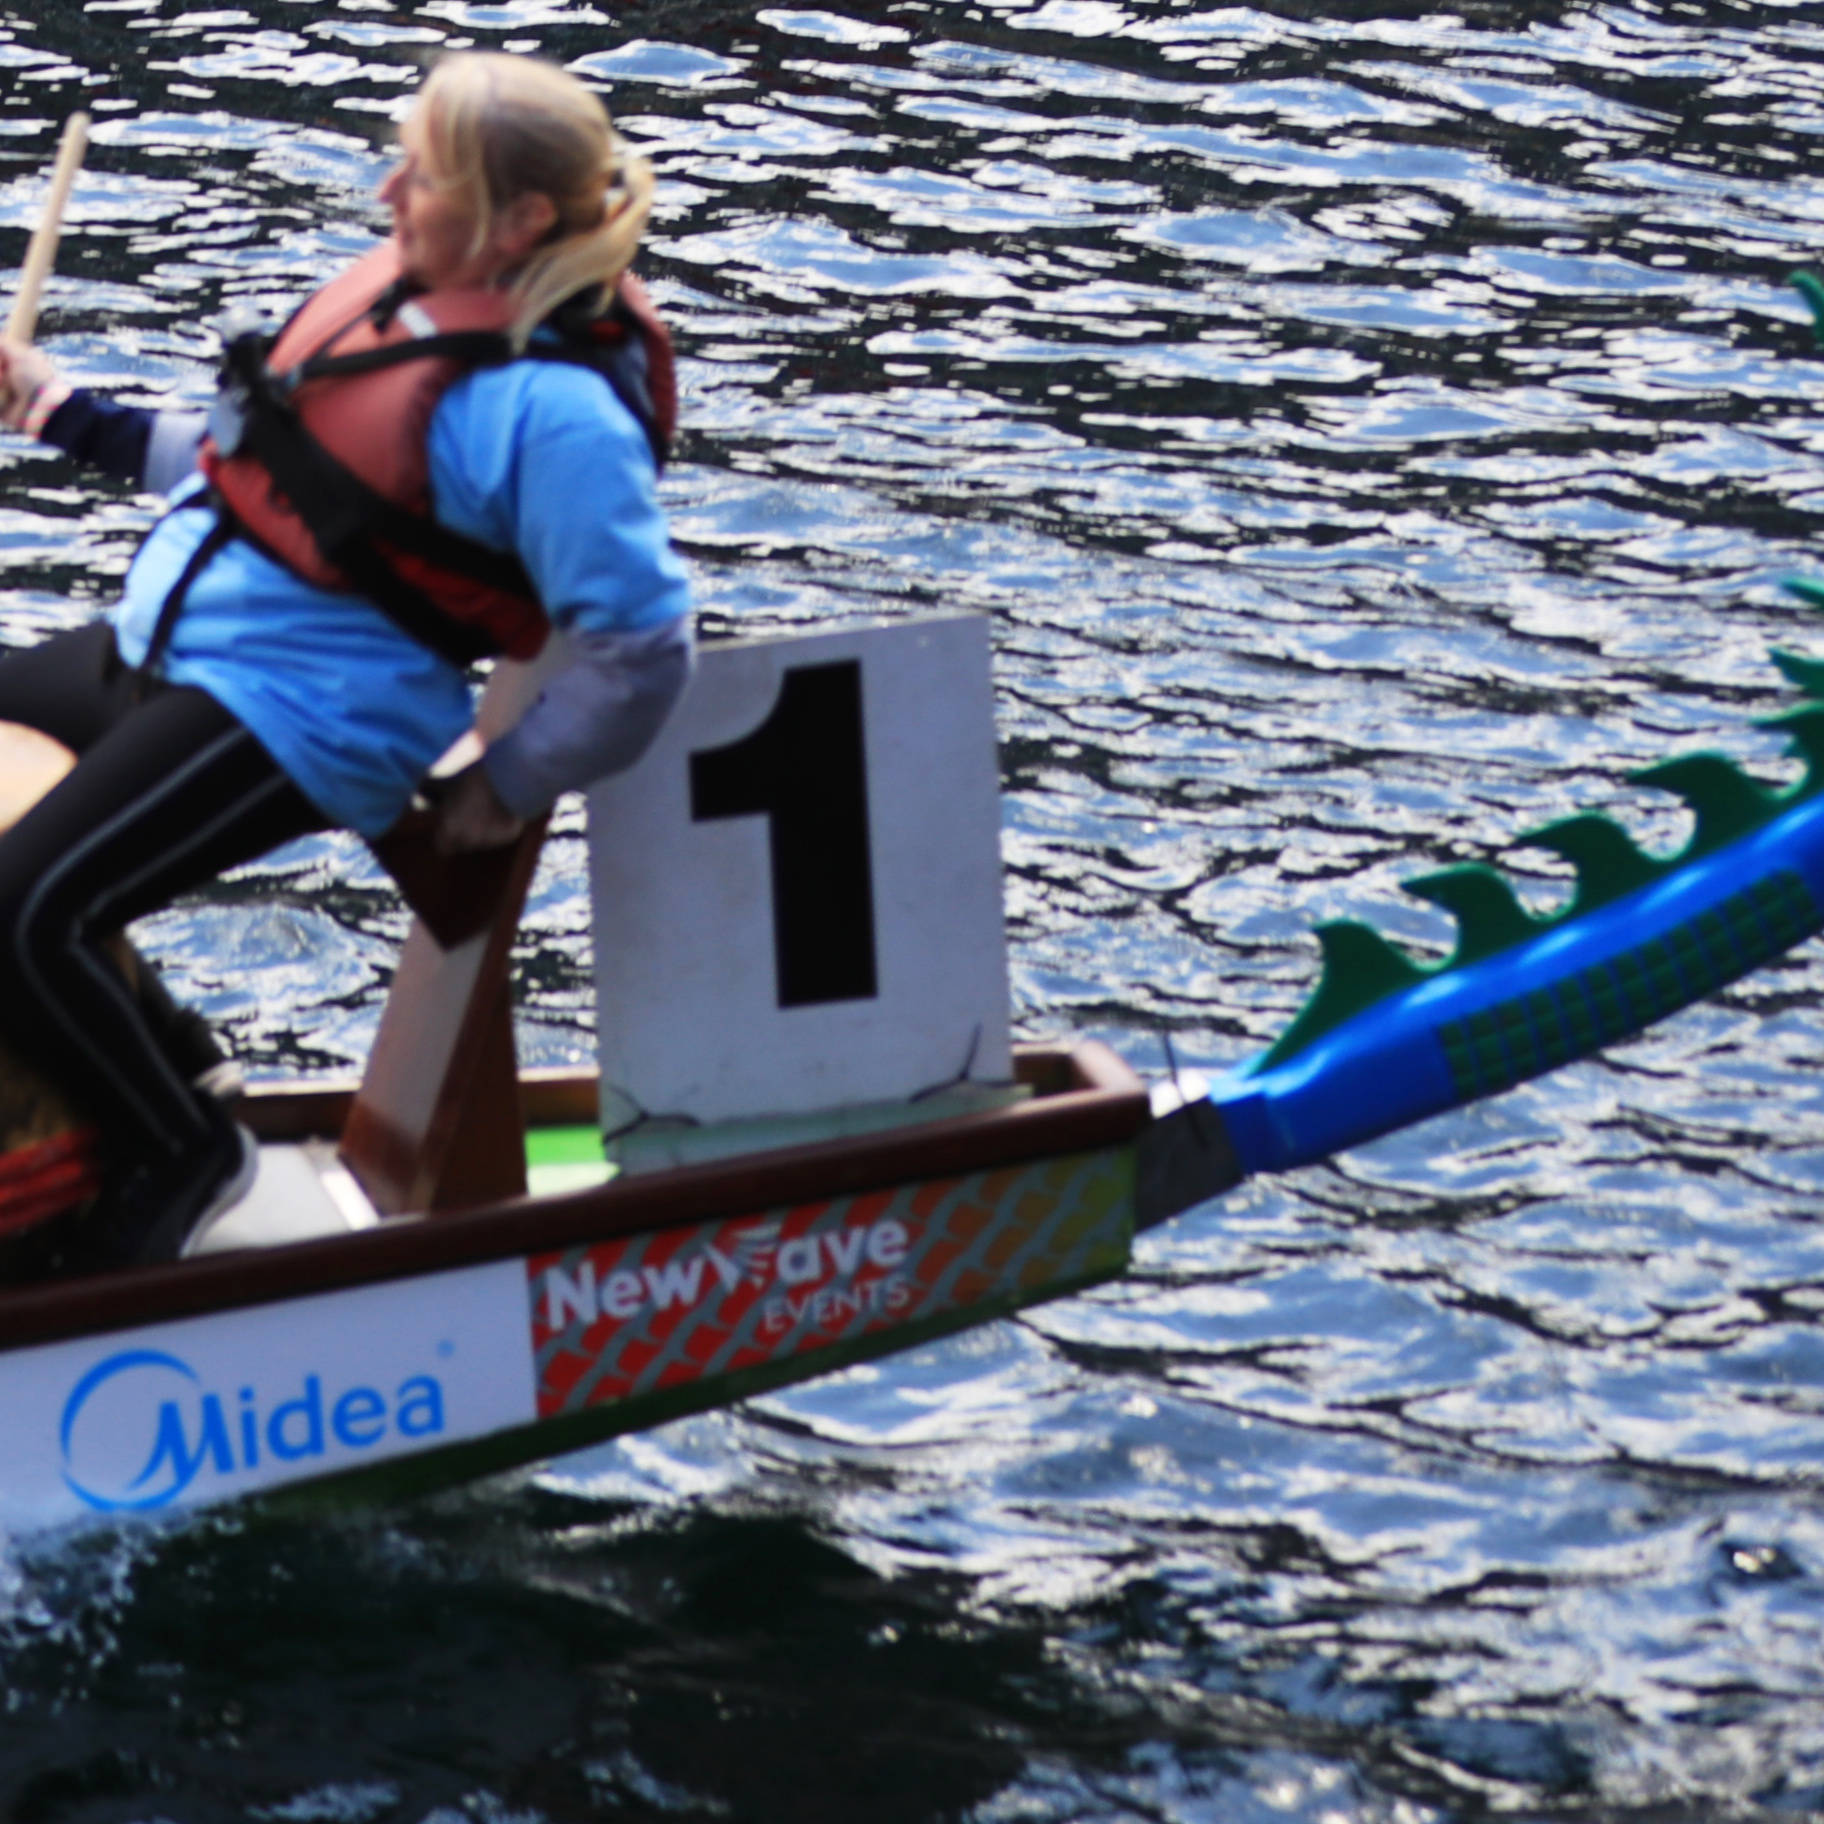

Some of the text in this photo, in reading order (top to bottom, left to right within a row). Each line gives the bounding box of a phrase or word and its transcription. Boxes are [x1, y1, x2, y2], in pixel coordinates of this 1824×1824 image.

[688, 659, 878, 1010] 1
[765, 1277, 909, 1331] EVENTS
[60, 1364, 445, 1512] Midea
